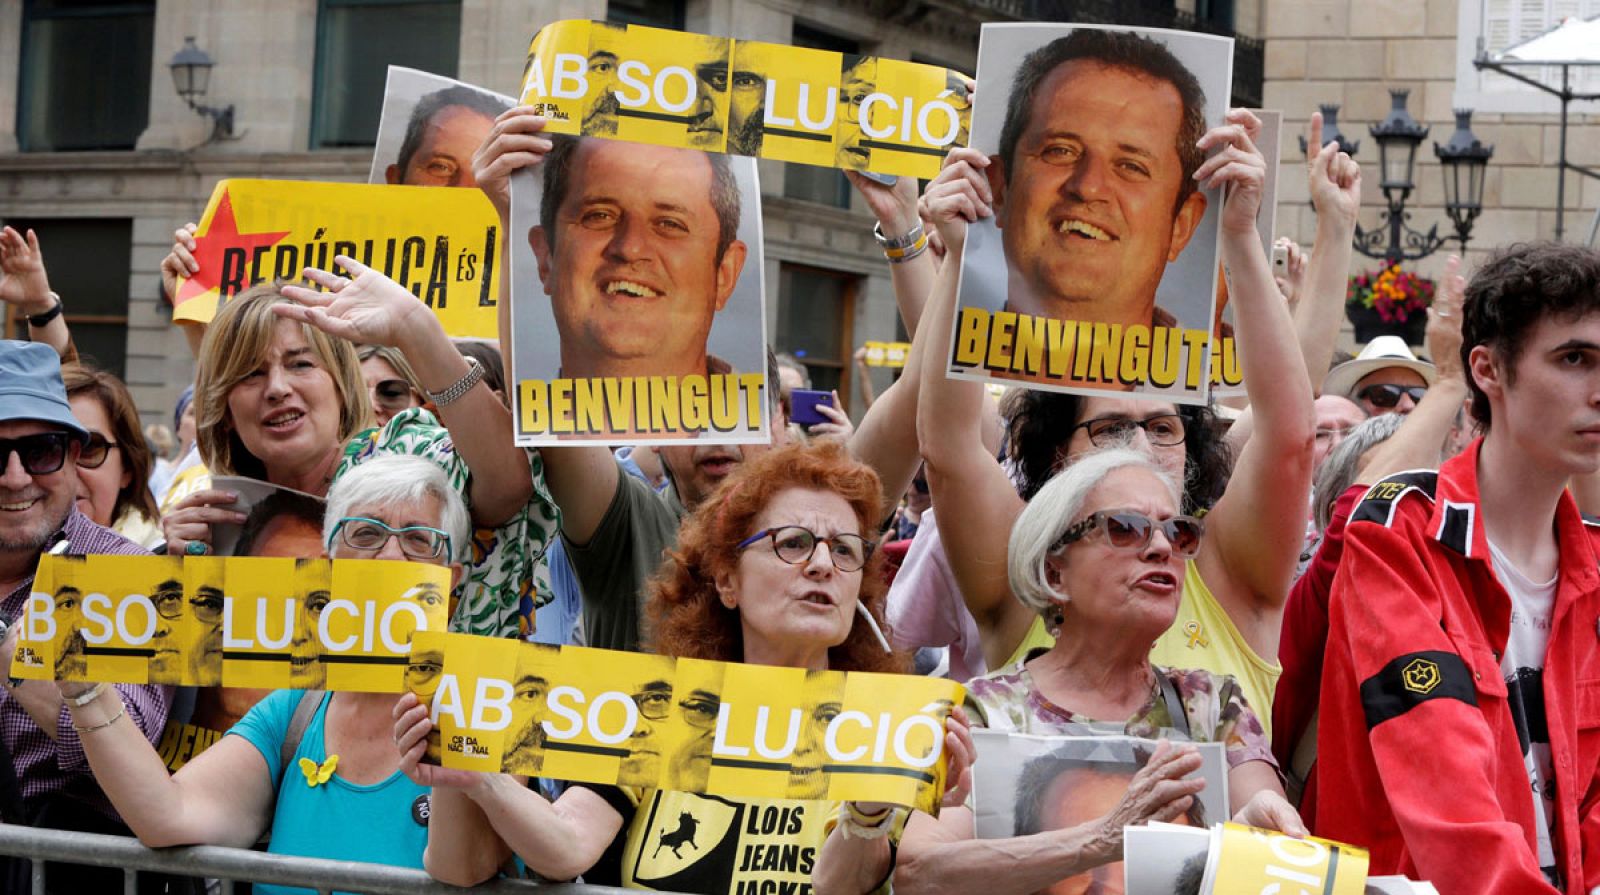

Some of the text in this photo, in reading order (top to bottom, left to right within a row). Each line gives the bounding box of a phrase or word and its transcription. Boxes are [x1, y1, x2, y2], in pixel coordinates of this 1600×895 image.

[614, 61, 697, 112] SO
[763, 79, 837, 130] LU
[858, 89, 961, 146] CIÓ
[456, 248, 478, 282] ÉS
[952, 306, 1208, 390] BENVINGUT
[517, 373, 765, 436] BENVINGUT
[80, 592, 157, 646] SO
[223, 596, 295, 650] LU
[430, 674, 944, 768] AB SO LU CIÓ
[746, 804, 805, 836] LOIS
[739, 844, 816, 876] JEANS
